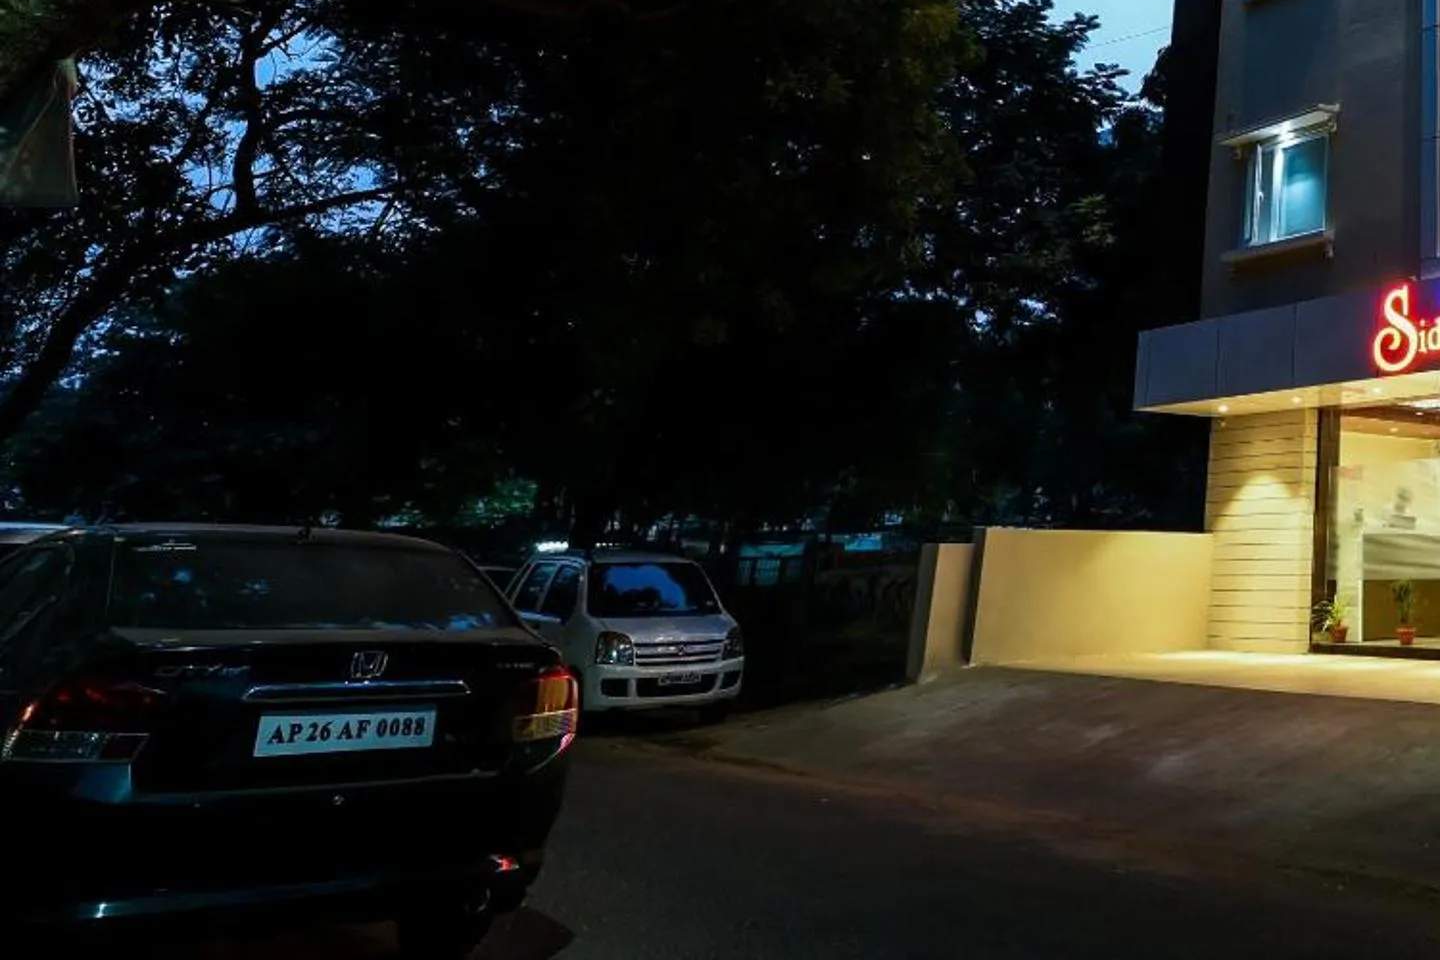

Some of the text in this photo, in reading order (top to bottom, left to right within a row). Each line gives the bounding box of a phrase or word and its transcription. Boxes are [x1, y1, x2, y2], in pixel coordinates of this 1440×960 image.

[267, 717, 426, 745] AP 26 AF 0088
